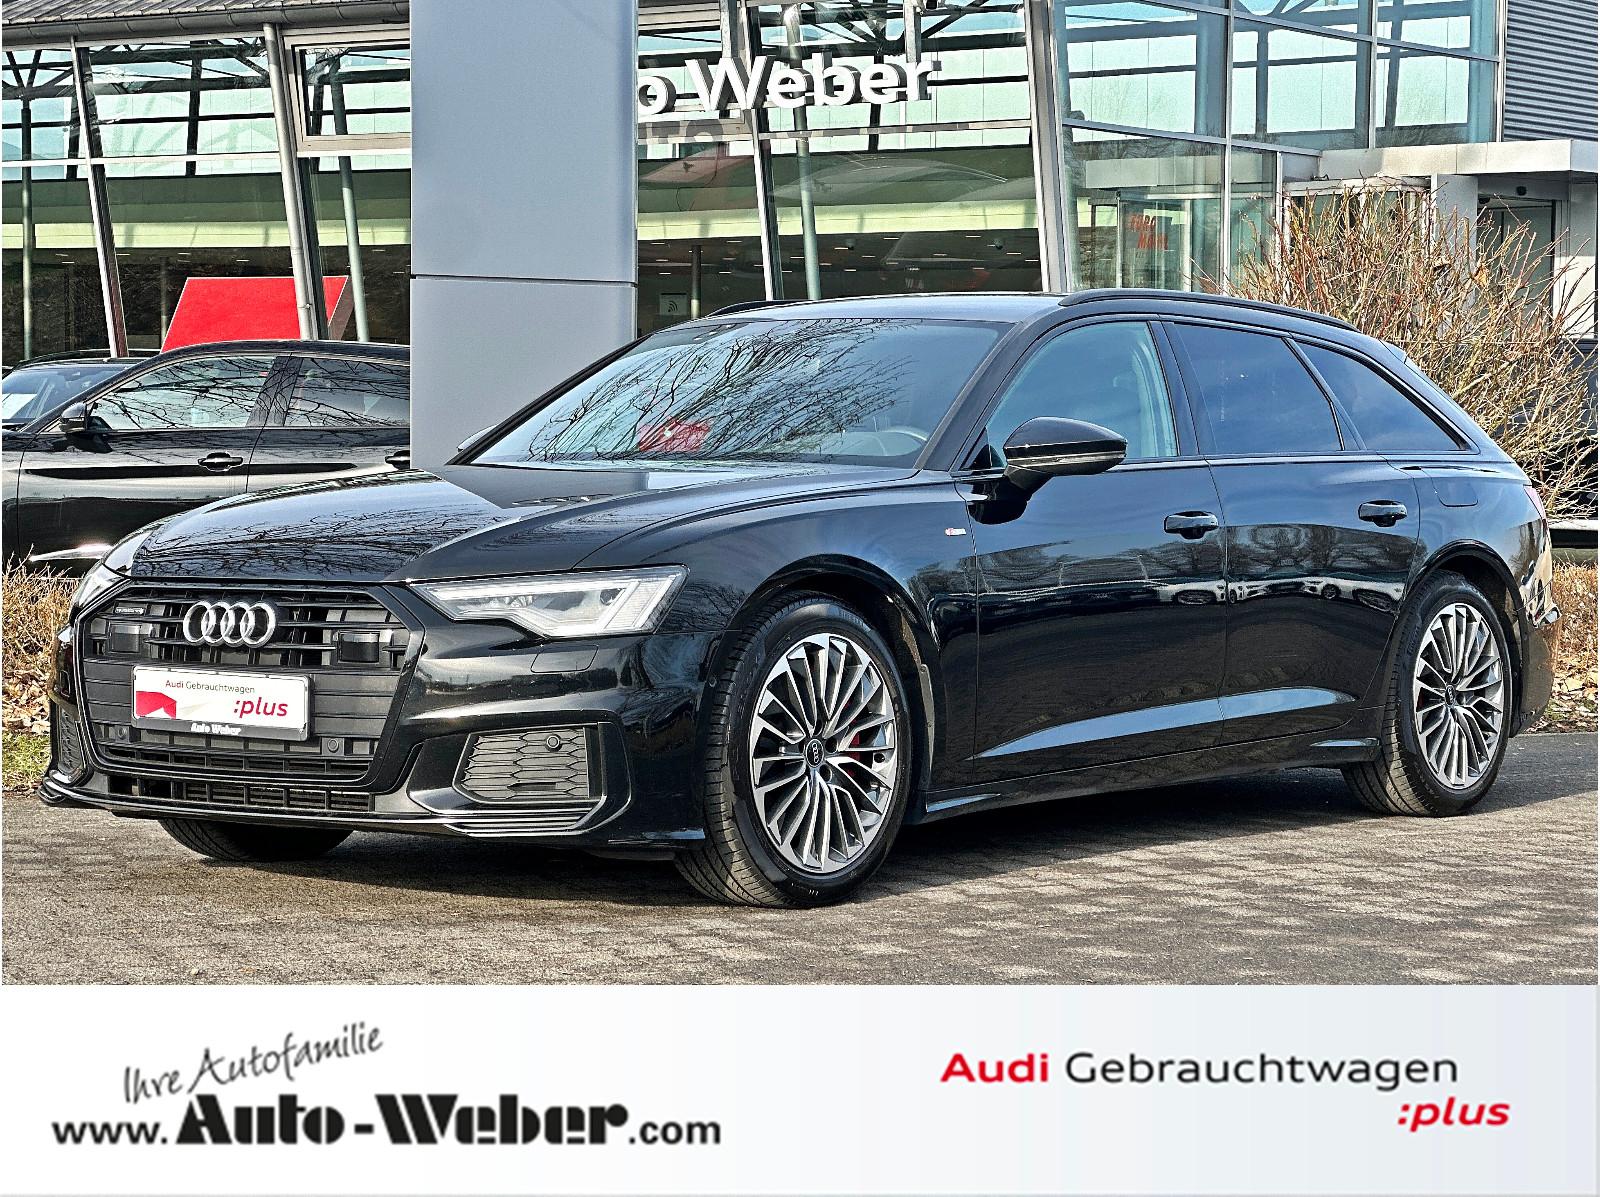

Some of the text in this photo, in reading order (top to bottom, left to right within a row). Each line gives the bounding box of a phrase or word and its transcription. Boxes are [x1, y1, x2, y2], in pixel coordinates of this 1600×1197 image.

[685, 52, 936, 111] Weber
[165, 679, 256, 695] Audi Gebrauchtwagen
[233, 696, 289, 719] :plus
